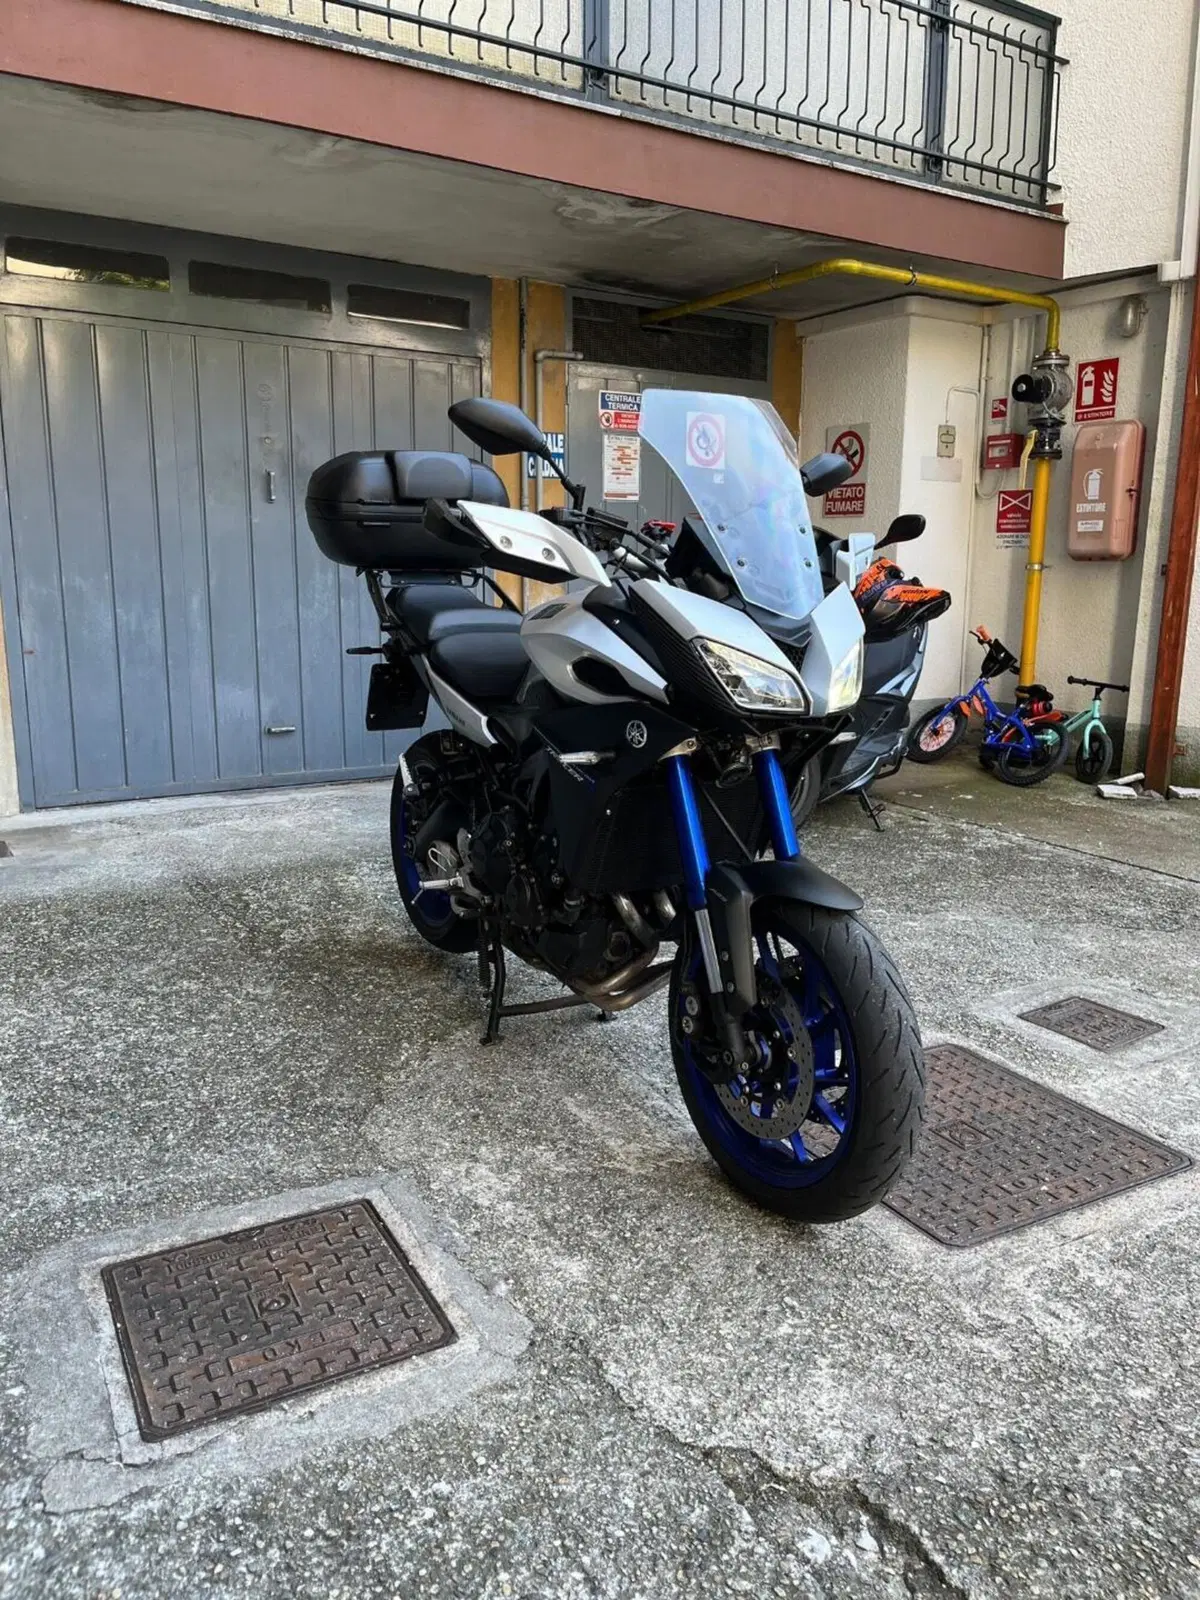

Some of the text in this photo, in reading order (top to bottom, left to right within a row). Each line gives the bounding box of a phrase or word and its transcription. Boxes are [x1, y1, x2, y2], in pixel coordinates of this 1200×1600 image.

[604, 393, 641, 404] CENTRALE
[607, 402, 638, 411] TERMICA
[827, 486, 864, 499] VIETATO
[825, 500, 864, 513] FUMARE
